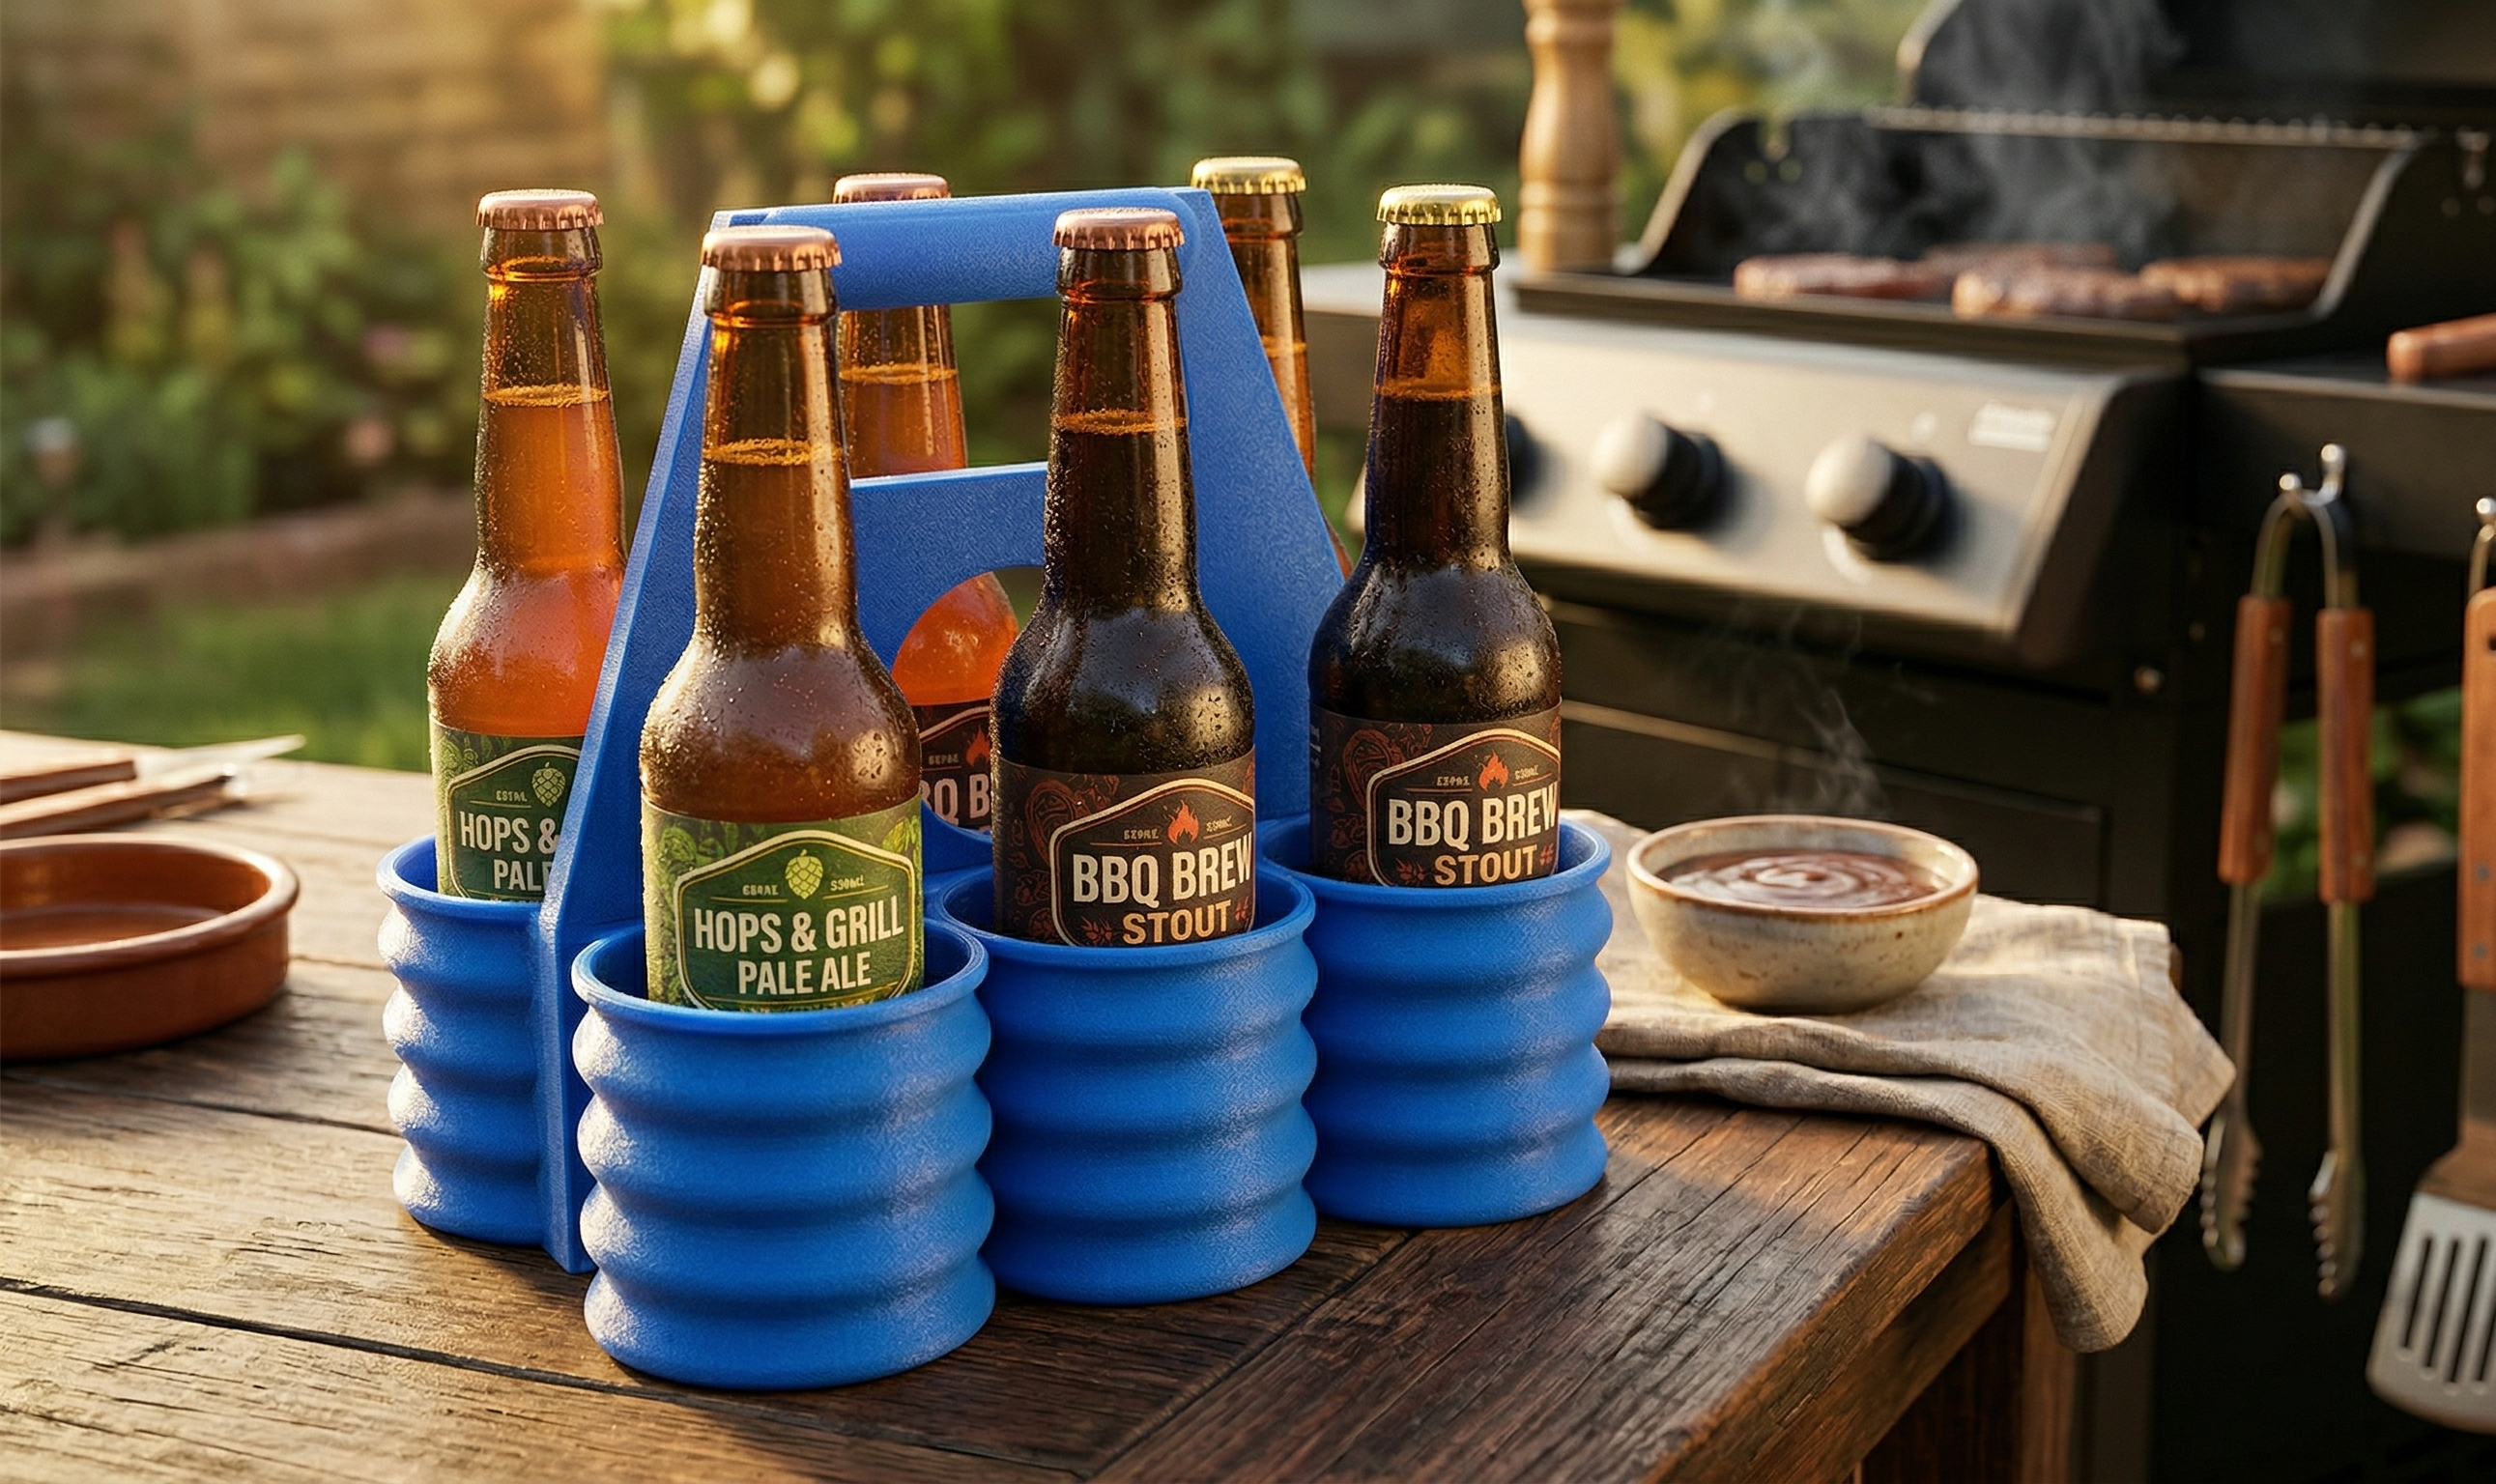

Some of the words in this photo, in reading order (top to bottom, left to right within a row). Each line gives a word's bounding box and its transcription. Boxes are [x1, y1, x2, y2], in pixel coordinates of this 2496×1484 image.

[459, 811, 531, 854] HOPS
[537, 817, 560, 854] &
[1389, 798, 1470, 851] BBQ
[1482, 782, 1558, 844] BREW
[1073, 854, 1160, 909] BBQ
[1172, 832, 1252, 900] BREW
[1434, 844, 1537, 886] STOUT
[694, 907, 783, 954] HOPS
[790, 911, 818, 953] &
[825, 895, 904, 950] GRILL
[1122, 900, 1232, 944] STOUT
[738, 959, 815, 995] PALE
[819, 951, 872, 992] ALE
